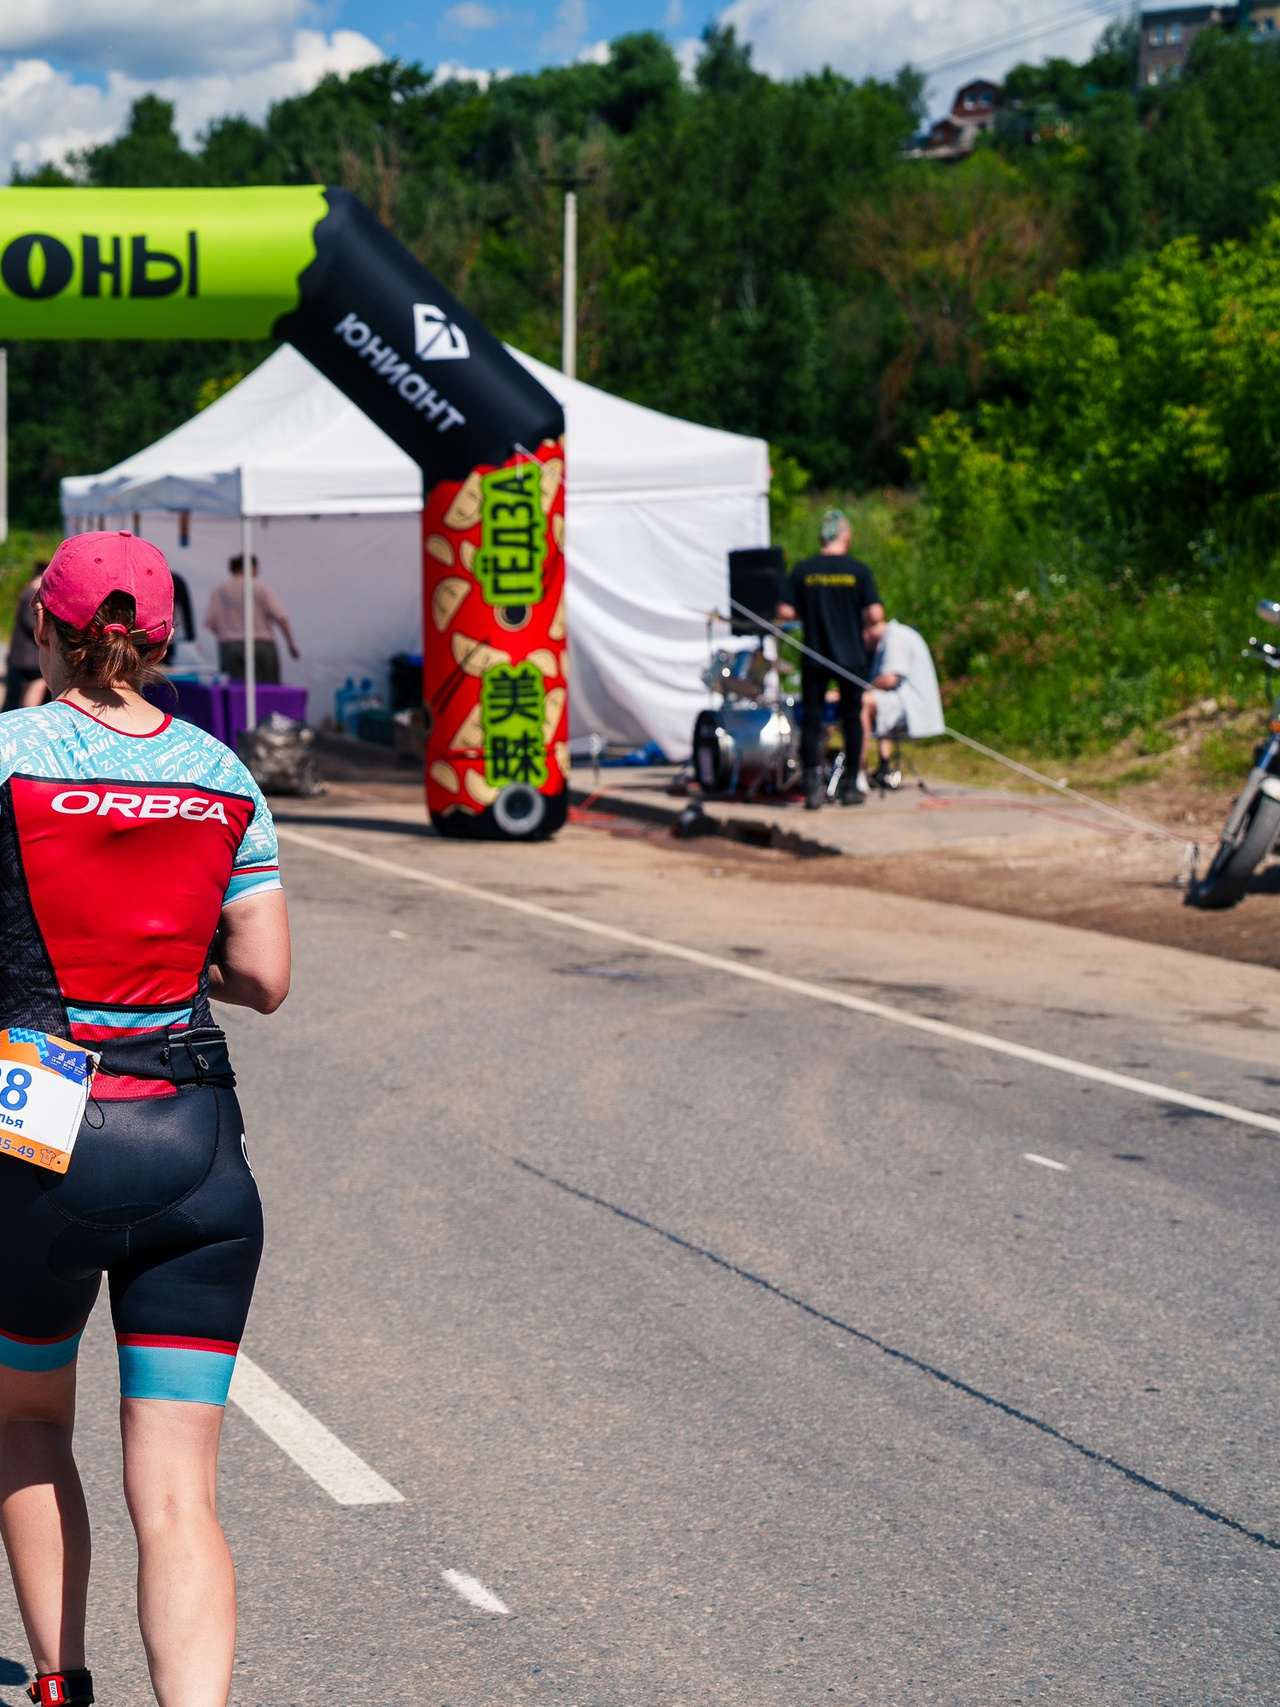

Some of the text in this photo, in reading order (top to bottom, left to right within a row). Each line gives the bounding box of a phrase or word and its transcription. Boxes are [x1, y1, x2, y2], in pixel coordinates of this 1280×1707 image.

[482, 473, 540, 595] ГЁДЗА
[73, 733, 120, 767] MAVIC
[50, 790, 229, 825] ORBEA
